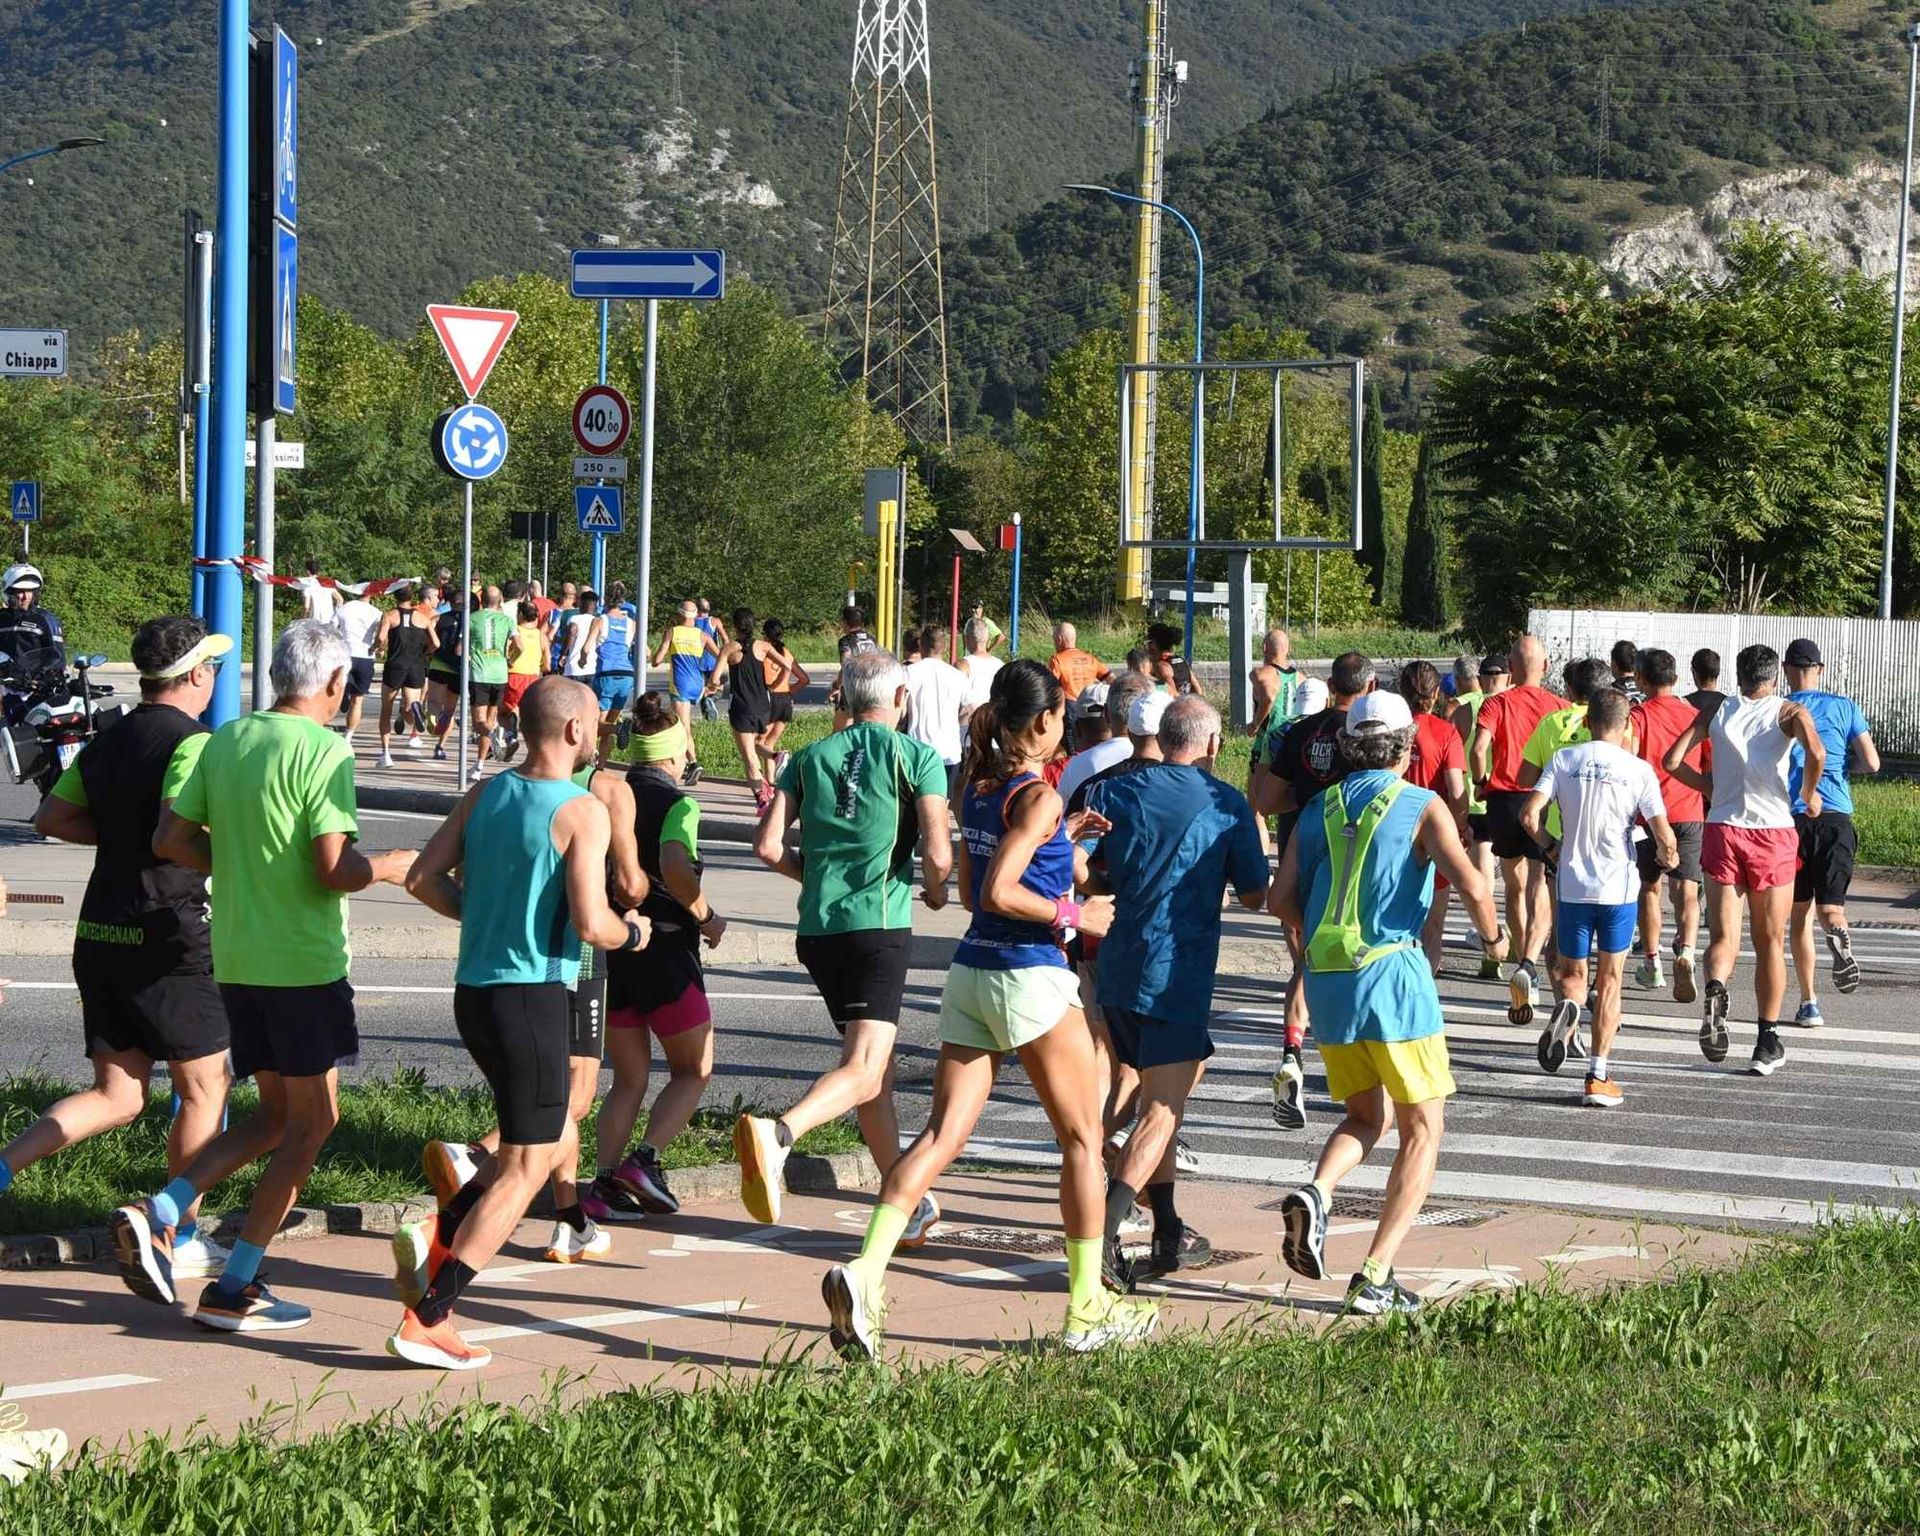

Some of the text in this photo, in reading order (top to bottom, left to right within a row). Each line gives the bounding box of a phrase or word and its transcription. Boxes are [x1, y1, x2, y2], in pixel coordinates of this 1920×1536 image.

[43, 335, 58, 346] via
[5, 352, 58, 370] Chiappa
[246, 452, 300, 462] Sssima
[583, 463, 603, 472] 250
[1312, 742, 1332, 757] OCR
[845, 748, 865, 819] MARATHON
